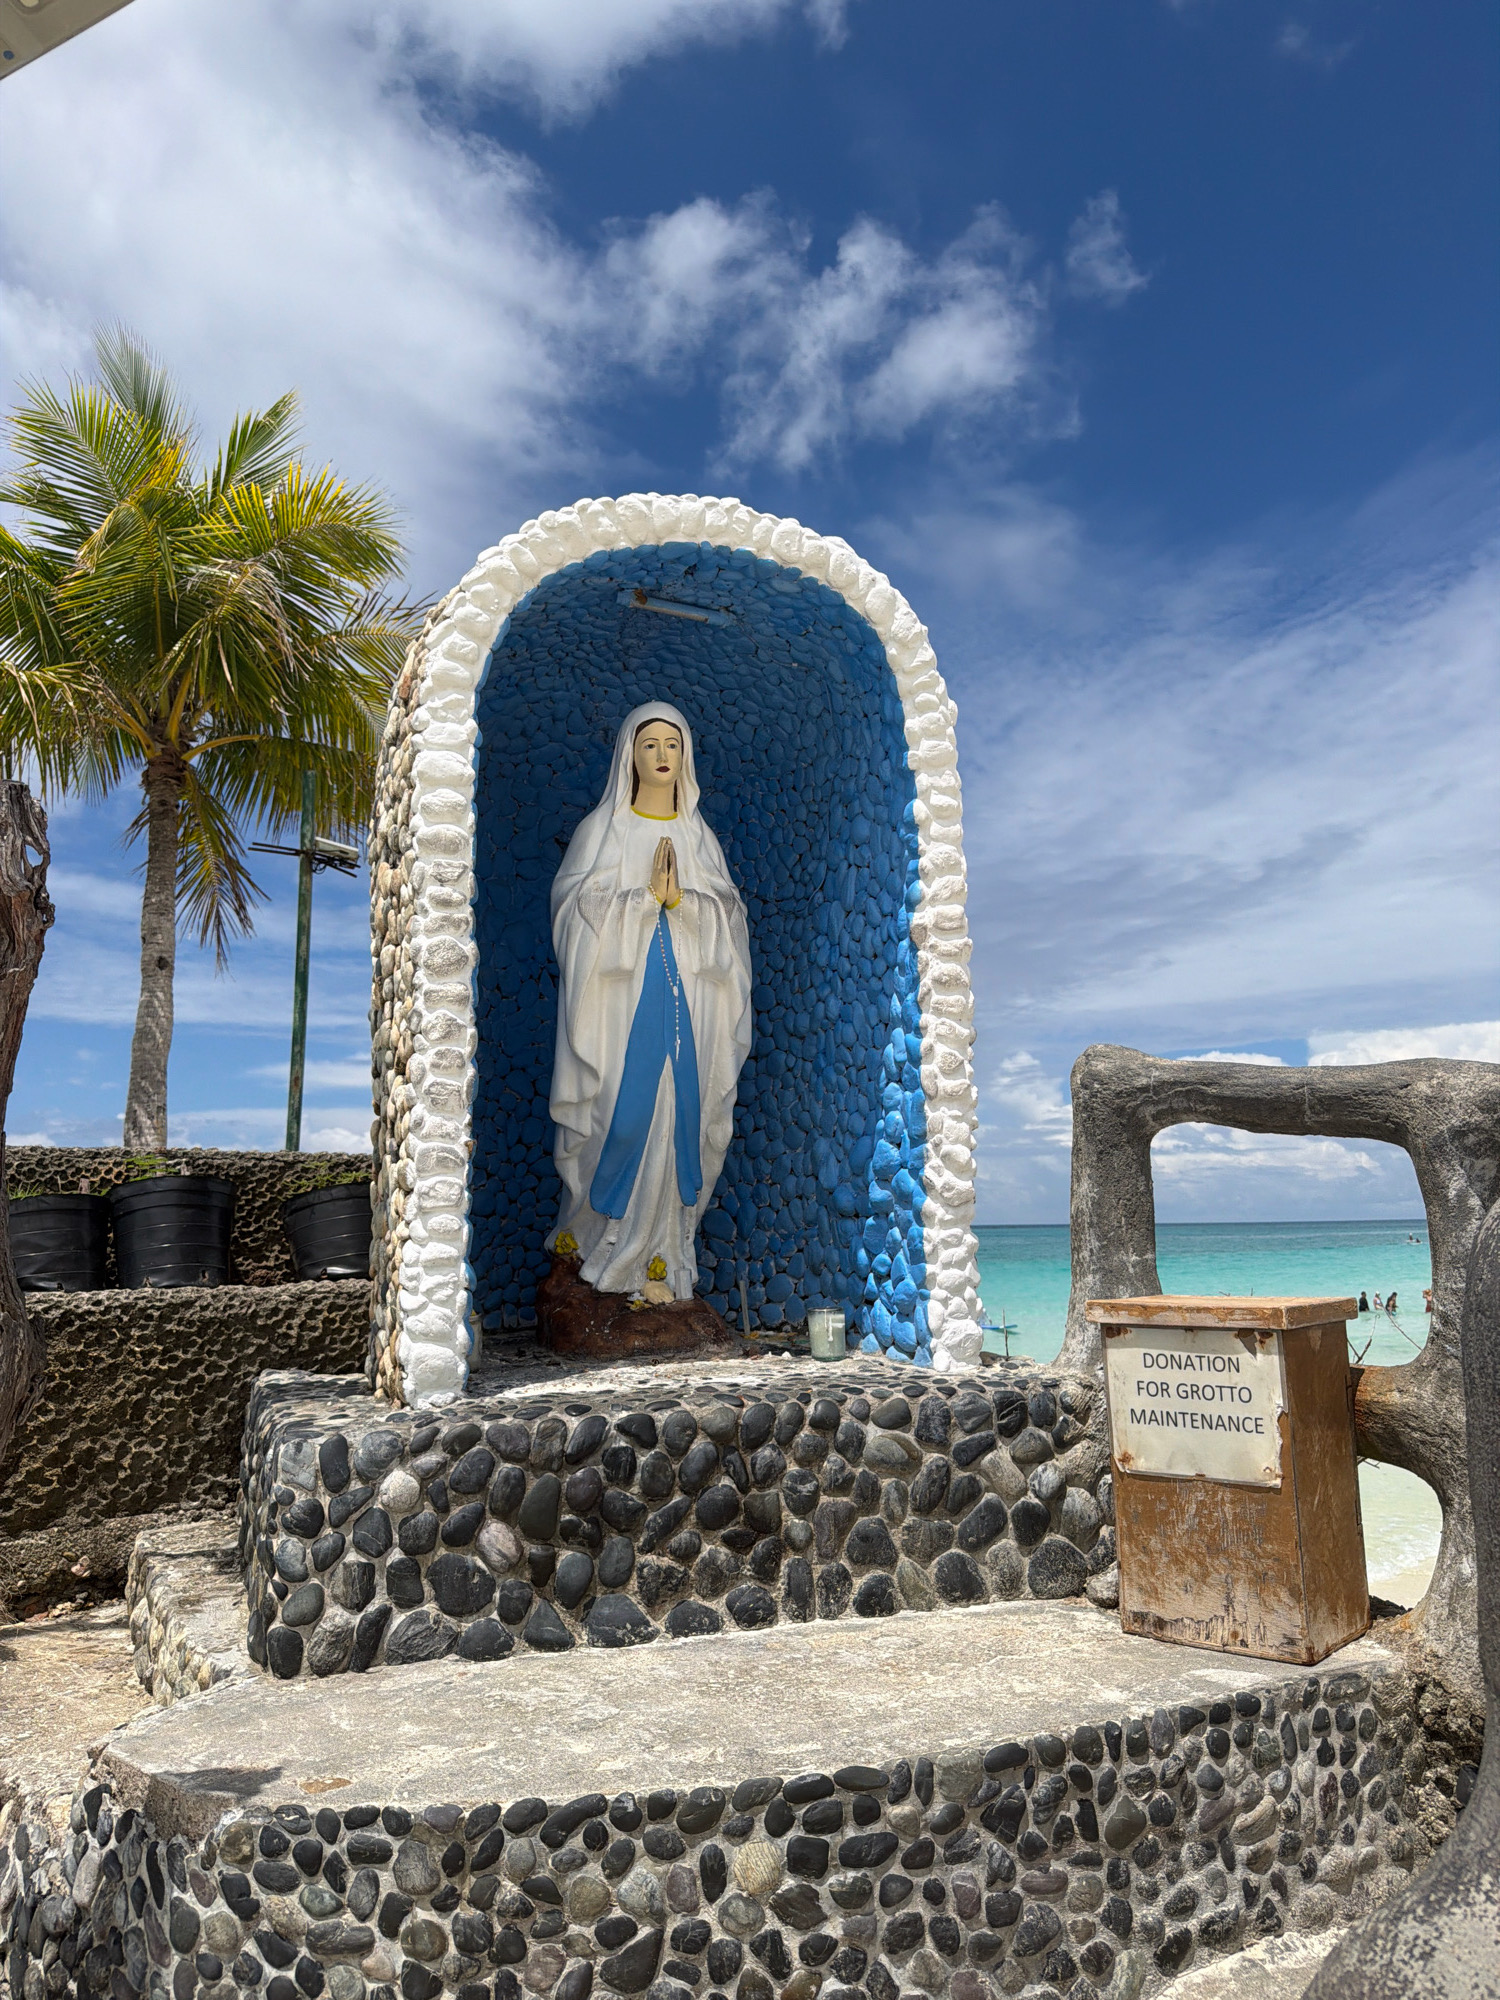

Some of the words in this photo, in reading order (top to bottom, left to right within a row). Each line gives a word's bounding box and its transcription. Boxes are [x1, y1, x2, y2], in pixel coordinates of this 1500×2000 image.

[1143, 1353, 1240, 1373] DONATION
[1137, 1380, 1171, 1398] FOR
[1176, 1383, 1253, 1403] GROTTO
[1130, 1408, 1265, 1434] MAINTENANCE
